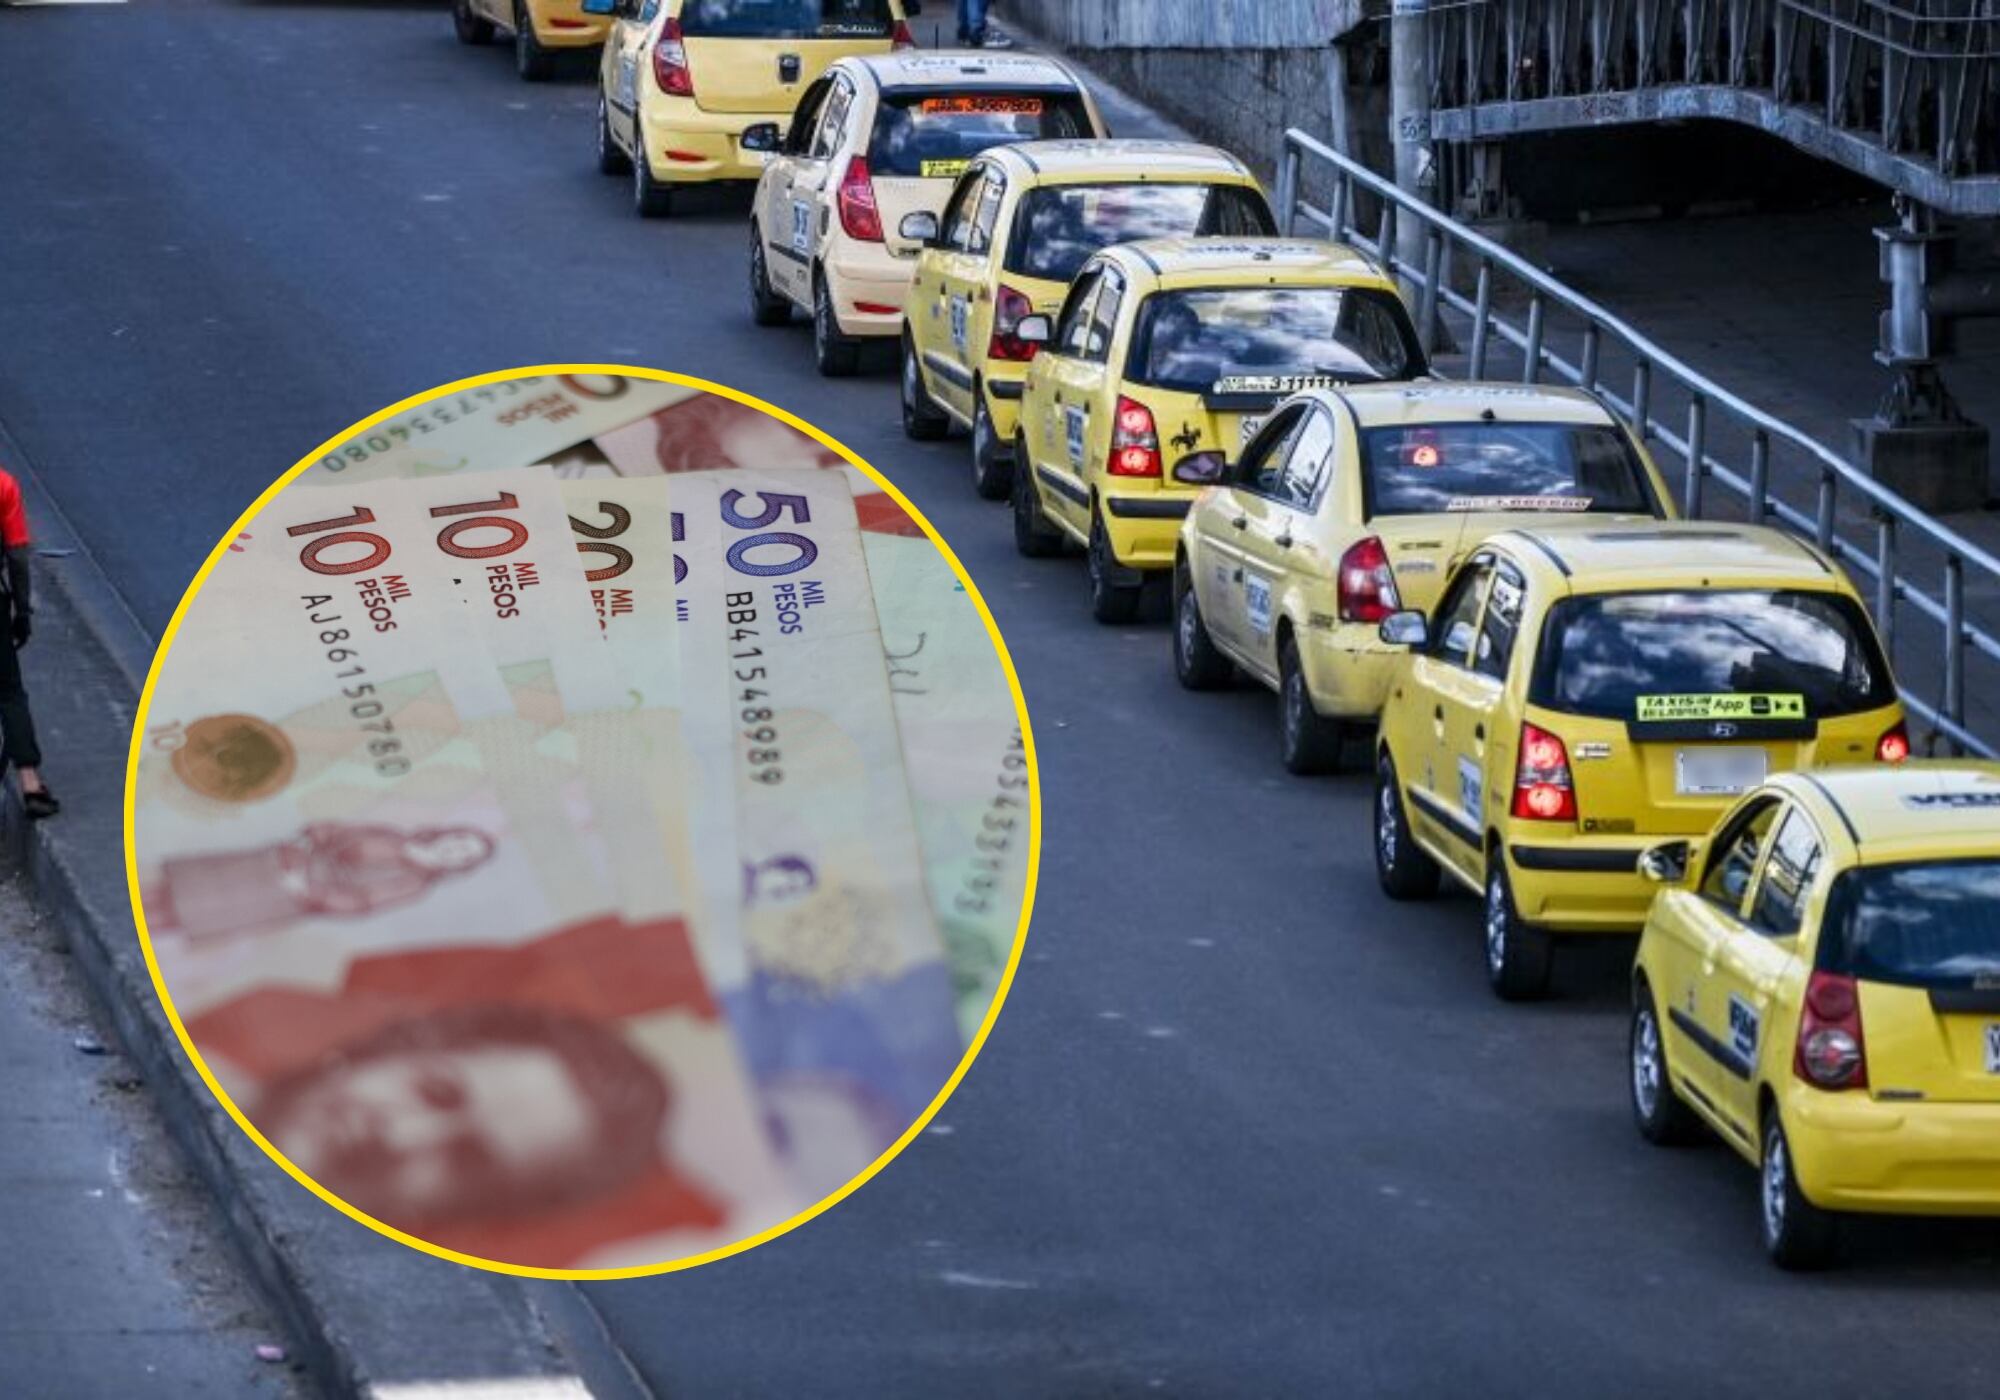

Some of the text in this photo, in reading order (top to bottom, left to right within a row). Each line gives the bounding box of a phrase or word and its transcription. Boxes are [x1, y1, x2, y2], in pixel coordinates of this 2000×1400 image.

[286, 505, 392, 576] 10
[429, 491, 529, 560] 10
[720, 488, 819, 578] 50
[382, 575, 413, 602] MIL
[485, 564, 520, 620] PESOS
[512, 562, 540, 591] MIL
[610, 588, 634, 618] MIL
[800, 580, 825, 609] MIL
[354, 578, 398, 633] PESOS
[772, 582, 803, 635] PESOS
[300, 594, 412, 778] AJ86150780
[725, 591, 784, 785] BB41548989
[1713, 699, 1745, 713] App
